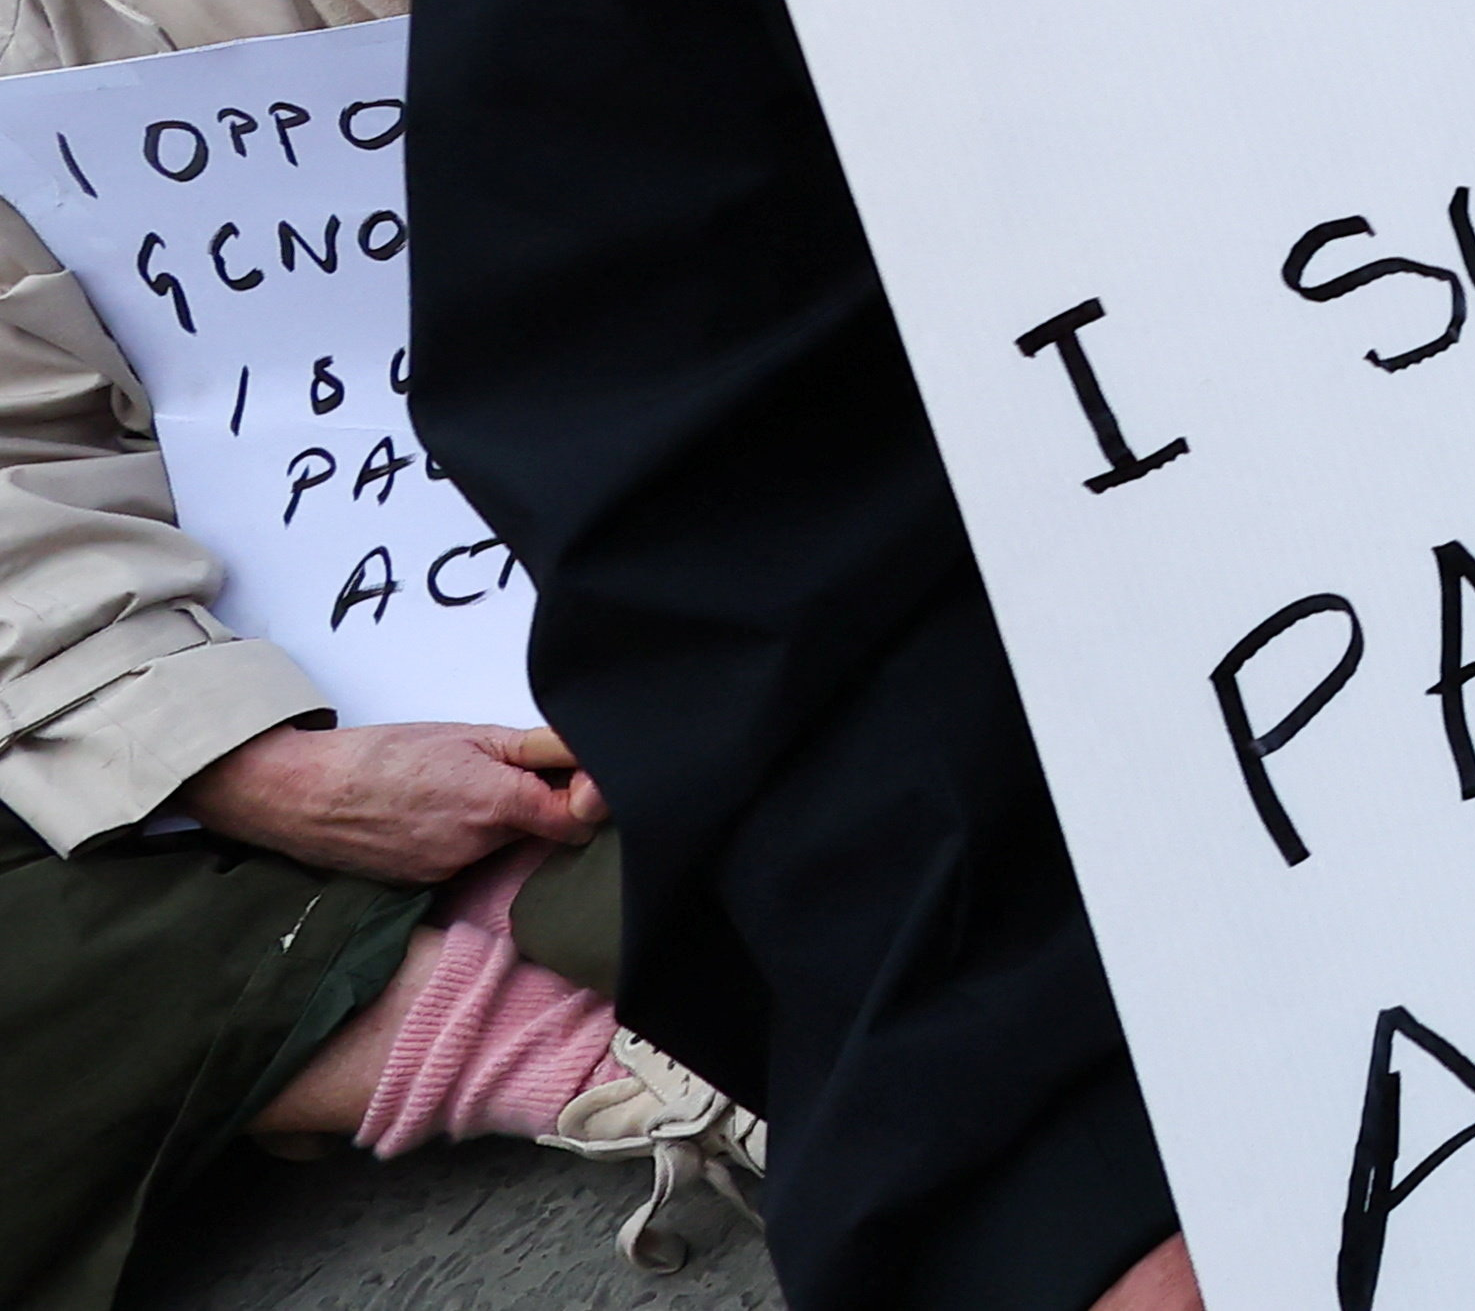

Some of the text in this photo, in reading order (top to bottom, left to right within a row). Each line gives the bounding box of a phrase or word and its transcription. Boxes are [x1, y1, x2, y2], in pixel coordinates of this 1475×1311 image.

[58, 97, 407, 199] I OPPO
[1015, 297, 1190, 493] I
